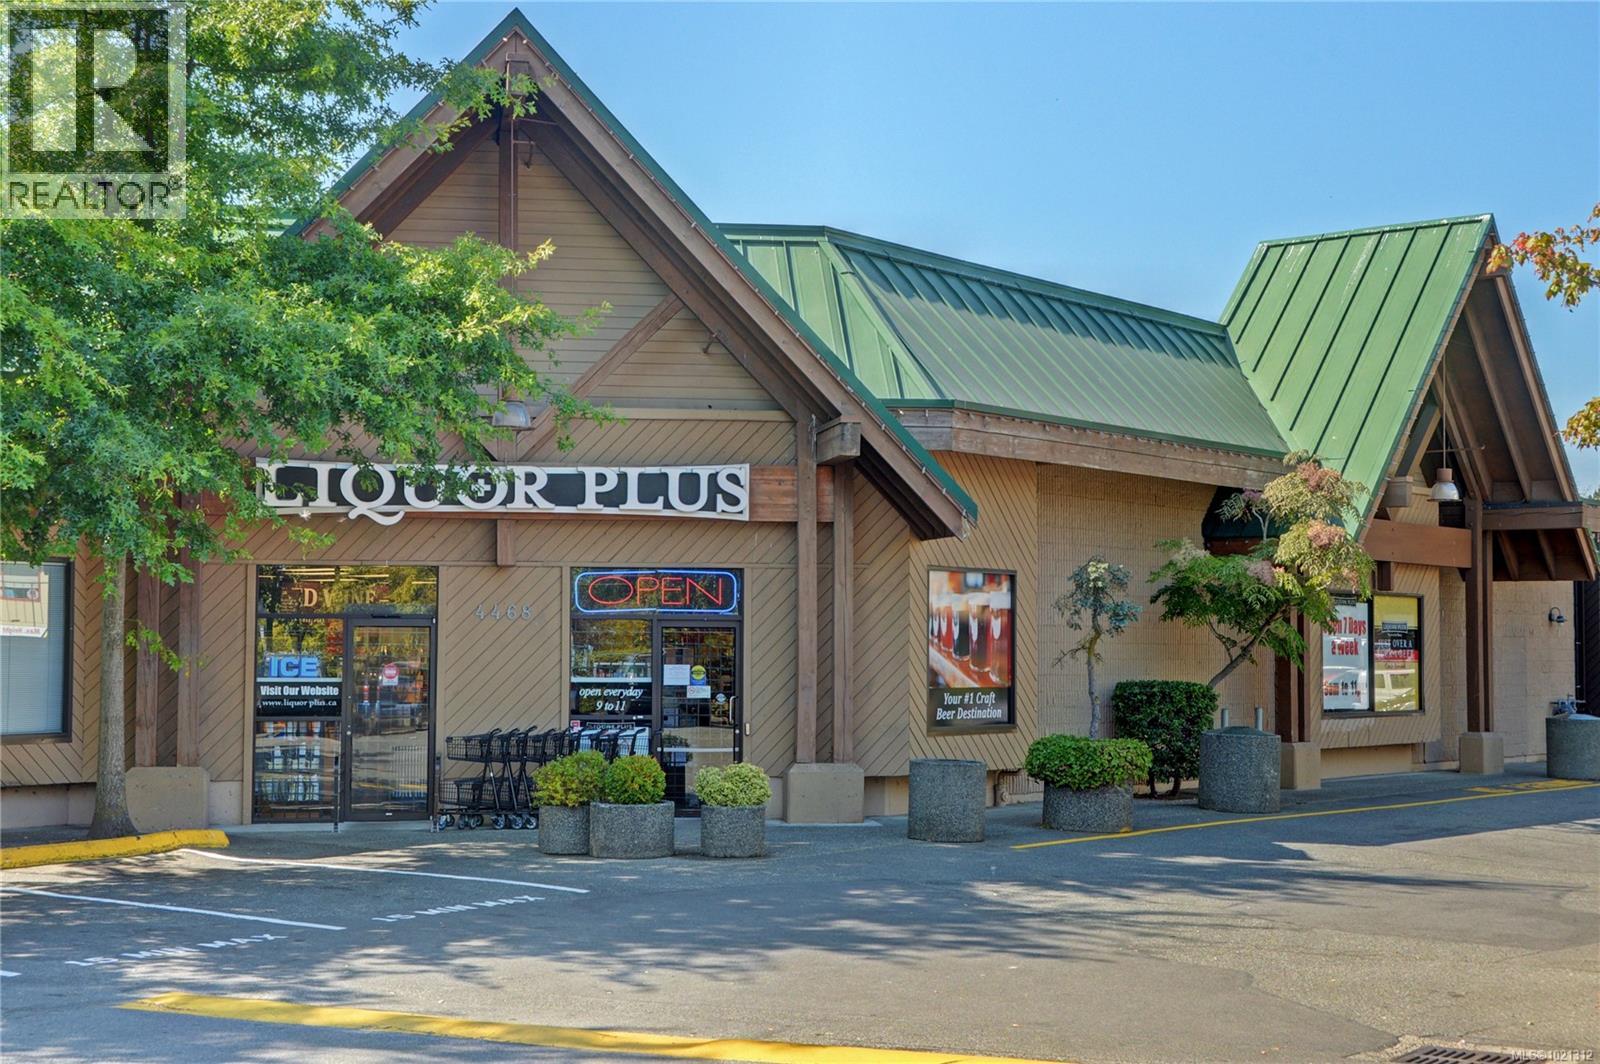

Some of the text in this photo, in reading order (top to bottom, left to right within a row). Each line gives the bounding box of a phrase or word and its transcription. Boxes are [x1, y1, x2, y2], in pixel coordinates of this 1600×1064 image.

[259, 462, 748, 526] LIQUOR PLUS
[588, 575, 722, 606] OPEN
[474, 602, 534, 620] 4468
[269, 656, 320, 677] ICE
[260, 685, 340, 696] Visit Our Website
[579, 686, 644, 699] open everyday
[944, 691, 996, 707] Your #1 Craft
[596, 701, 603, 711] 9
[604, 701, 614, 711] to
[936, 706, 1002, 720] Beer Destination
[413, 904, 478, 915] MIN
[472, 895, 546, 907] MAX
[120, 946, 201, 959] MIN
[197, 933, 289, 948] MAX
